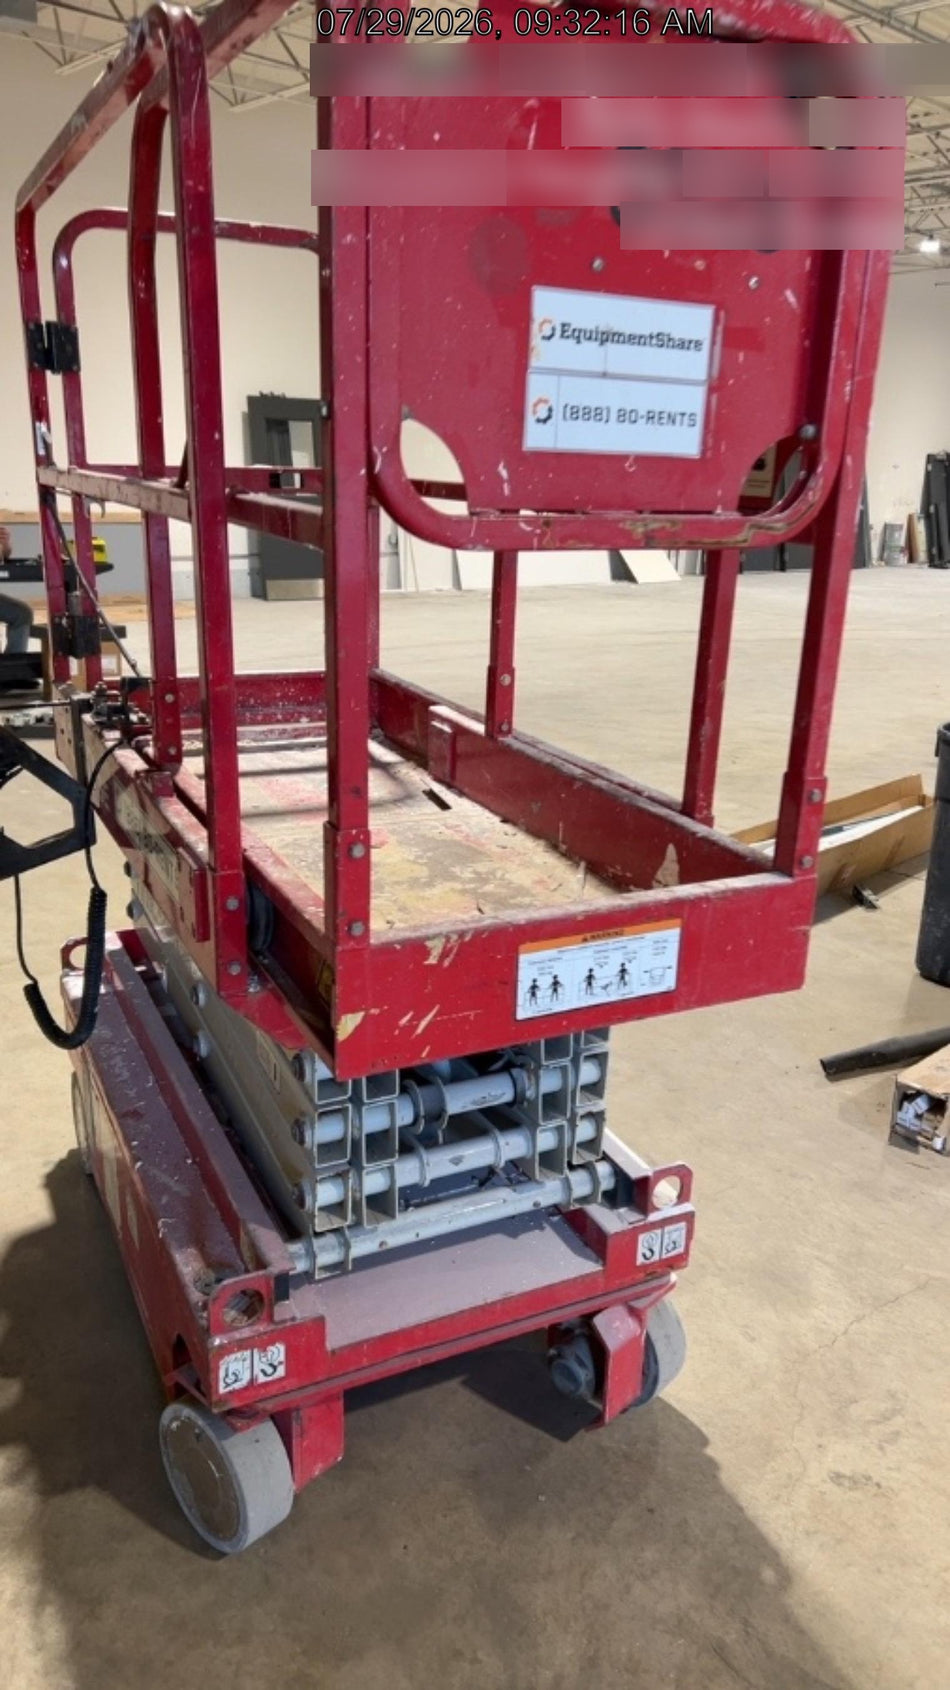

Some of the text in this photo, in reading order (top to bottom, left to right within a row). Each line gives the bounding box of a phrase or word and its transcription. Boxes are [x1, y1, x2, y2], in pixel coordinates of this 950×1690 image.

[559, 322, 704, 351] EquipmentShare
[562, 403, 698, 428] (888) 80-RENTS
